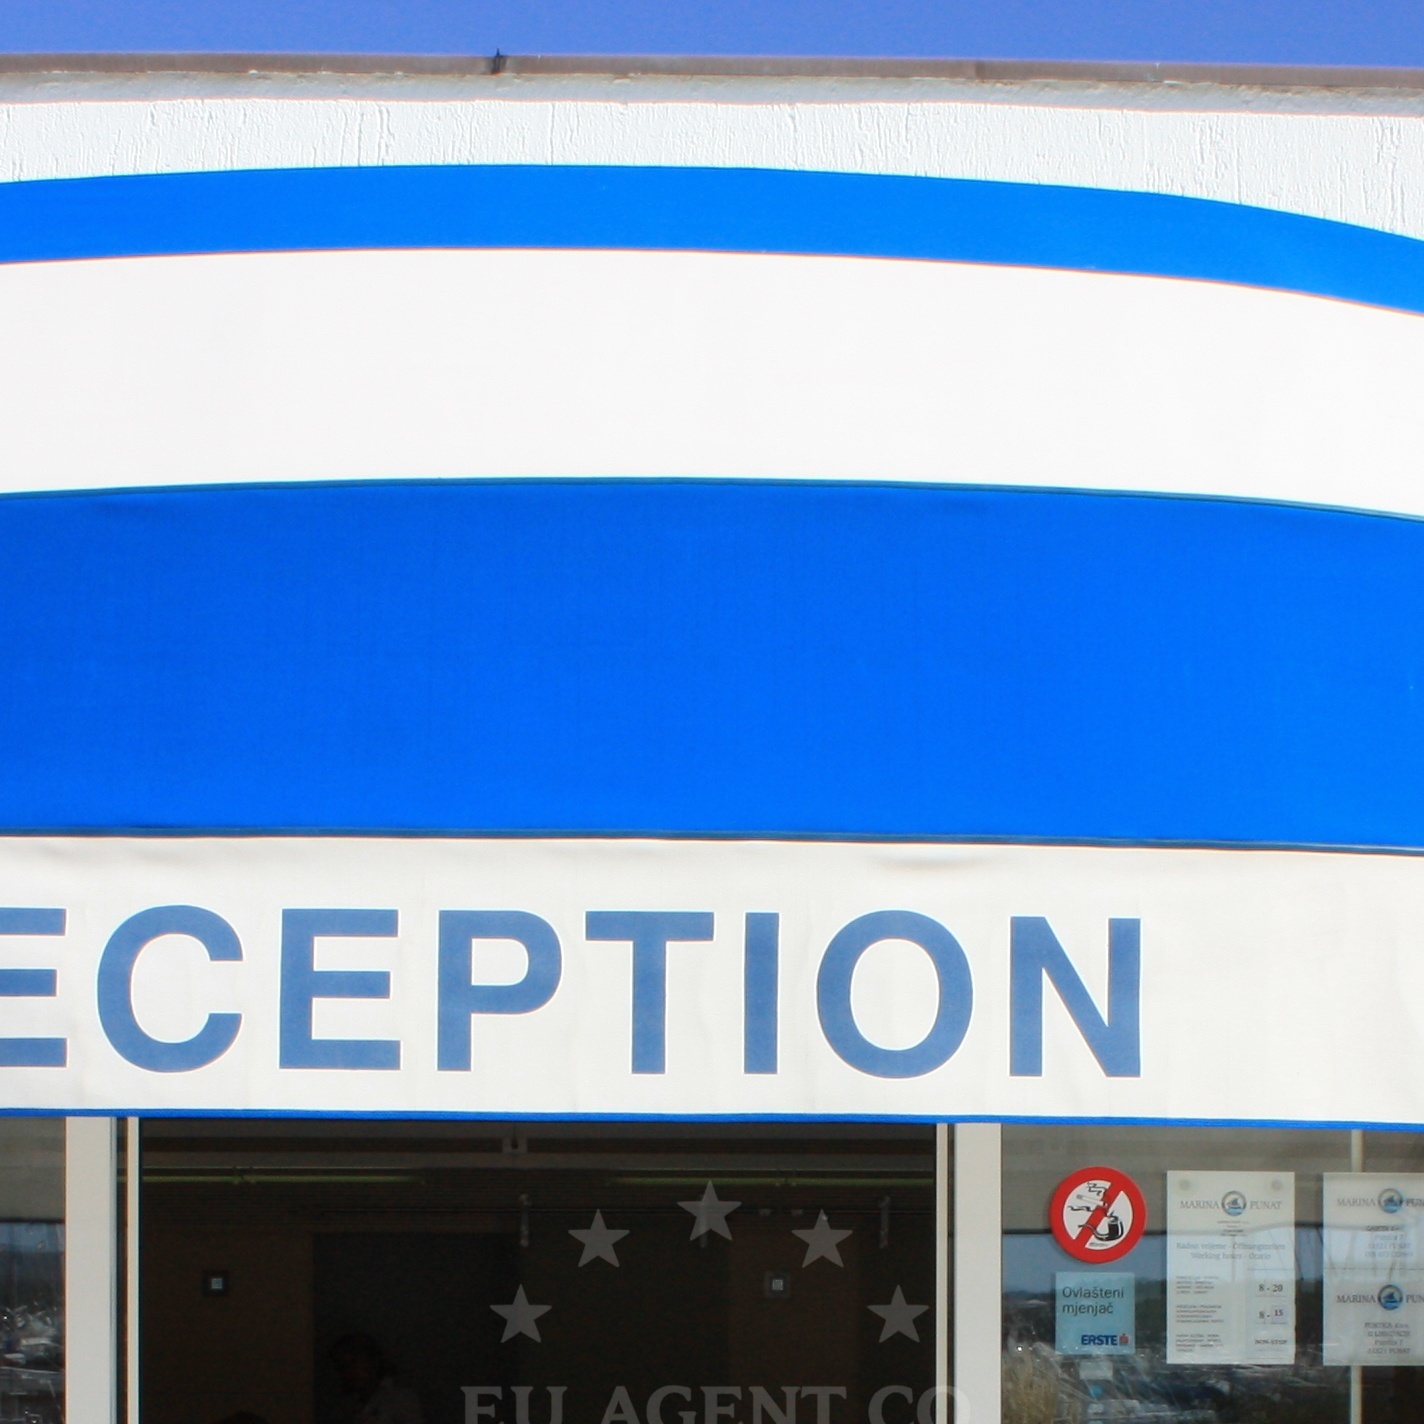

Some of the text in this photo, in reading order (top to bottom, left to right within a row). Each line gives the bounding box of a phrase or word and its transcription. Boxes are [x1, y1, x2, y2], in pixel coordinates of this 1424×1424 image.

[1180, 1200, 1283, 1210] MARINA PUNAT
[1336, 1198, 1376, 1207] MARINA
[1062, 1286, 1124, 1298] Ovlašteni
[1258, 1284, 1265, 1292] 8
[1272, 1284, 1283, 1292] 20
[1336, 1294, 1376, 1303] MARINA
[1062, 1302, 1114, 1316] mjenjač
[1274, 1309, 1283, 1317] 15
[1081, 1334, 1118, 1346] ERSTE
